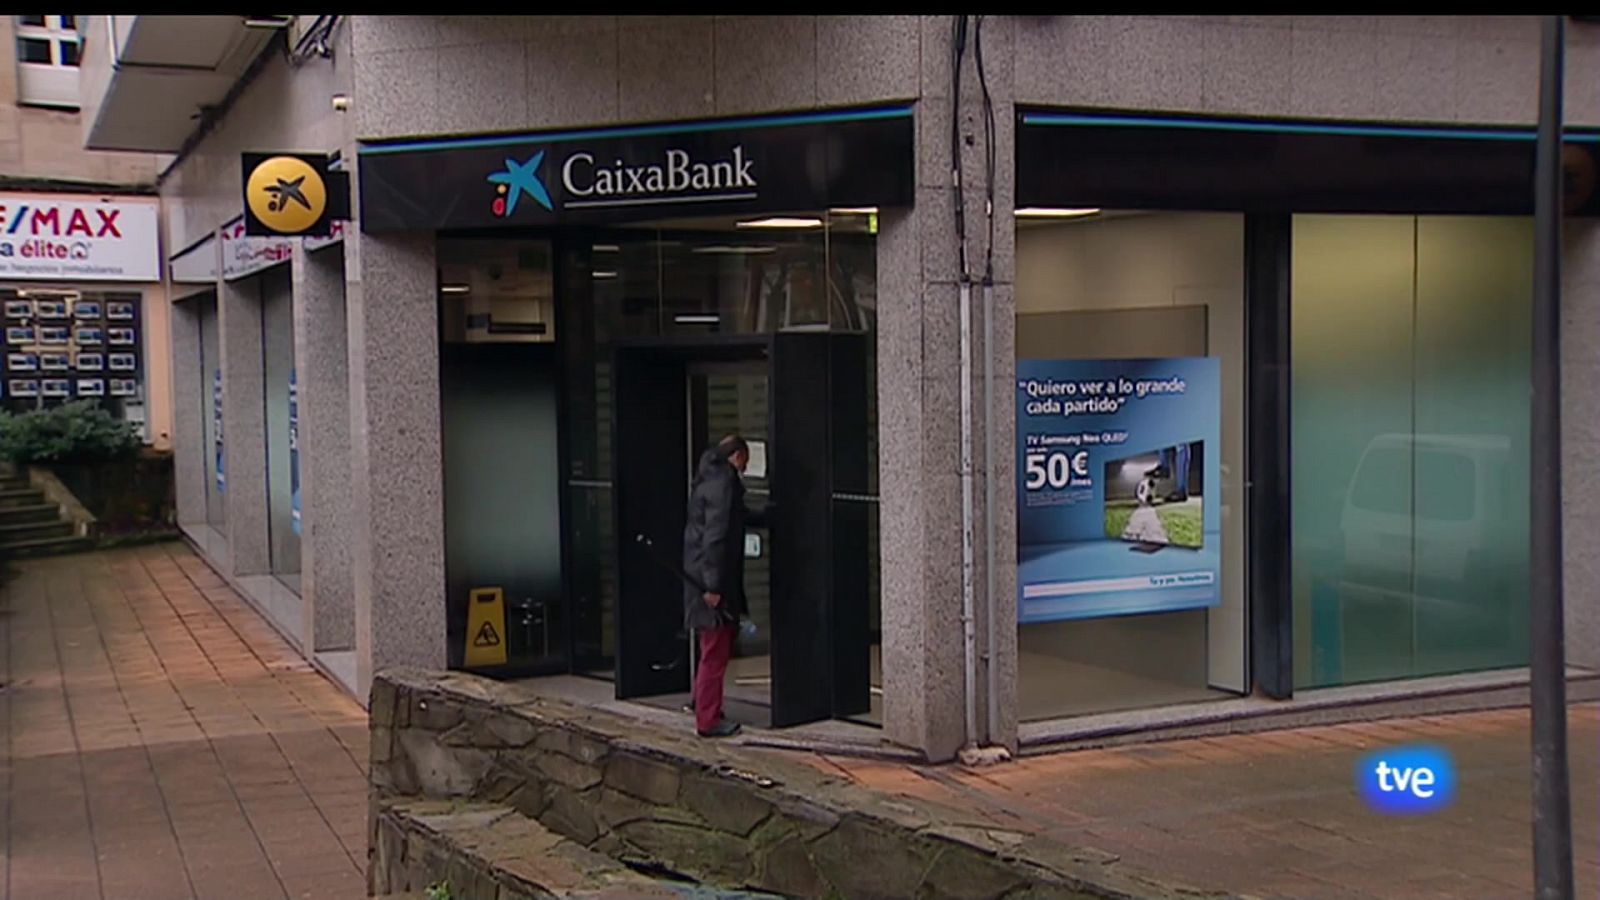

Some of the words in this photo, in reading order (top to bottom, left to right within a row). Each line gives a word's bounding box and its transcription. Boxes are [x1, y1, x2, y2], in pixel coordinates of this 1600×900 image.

[562, 146, 757, 195] CaixaBank
[20, 240, 68, 258] élite
[1080, 382, 1105, 395] ver
[1106, 382, 1116, 394] a
[1118, 378, 1133, 394] lo
[1136, 377, 1186, 397] grande
[1026, 399, 1061, 414] cada
[1027, 435, 1038, 445] TV
[1041, 434, 1081, 445] Samsung
